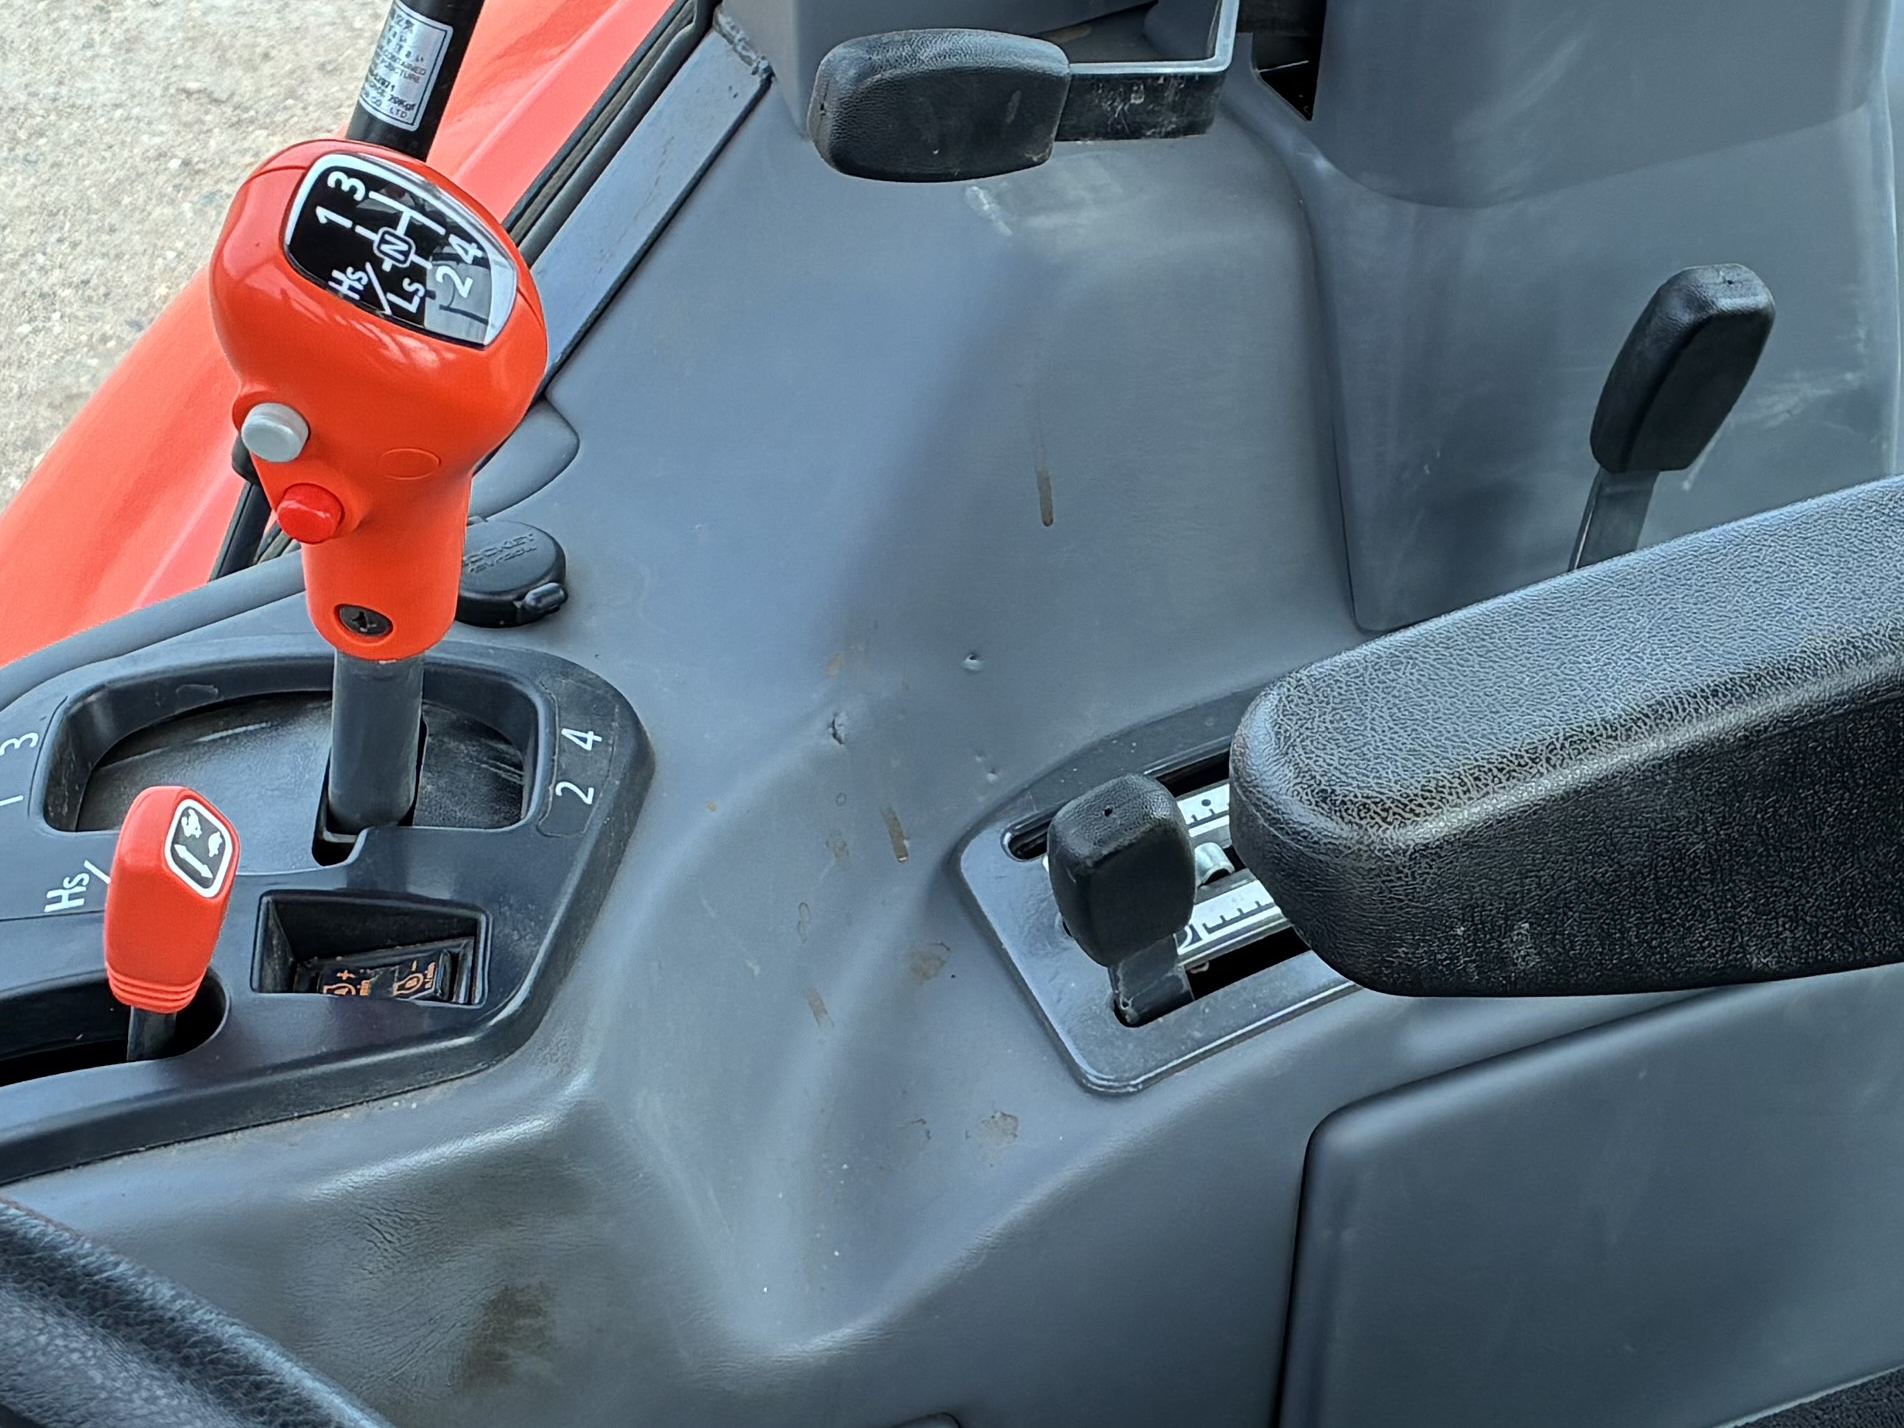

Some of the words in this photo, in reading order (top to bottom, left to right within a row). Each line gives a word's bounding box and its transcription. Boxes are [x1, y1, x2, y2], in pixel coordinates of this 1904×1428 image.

[327, 170, 366, 202] 3
[315, 205, 353, 229] 1
[378, 232, 410, 263] N
[448, 233, 484, 265] 4
[327, 266, 369, 301] Hs
[386, 277, 426, 314] Ls
[435, 265, 474, 299] 2
[561, 728, 603, 751] 4
[555, 781, 595, 805] 2
[44, 872, 90, 913] Hs
